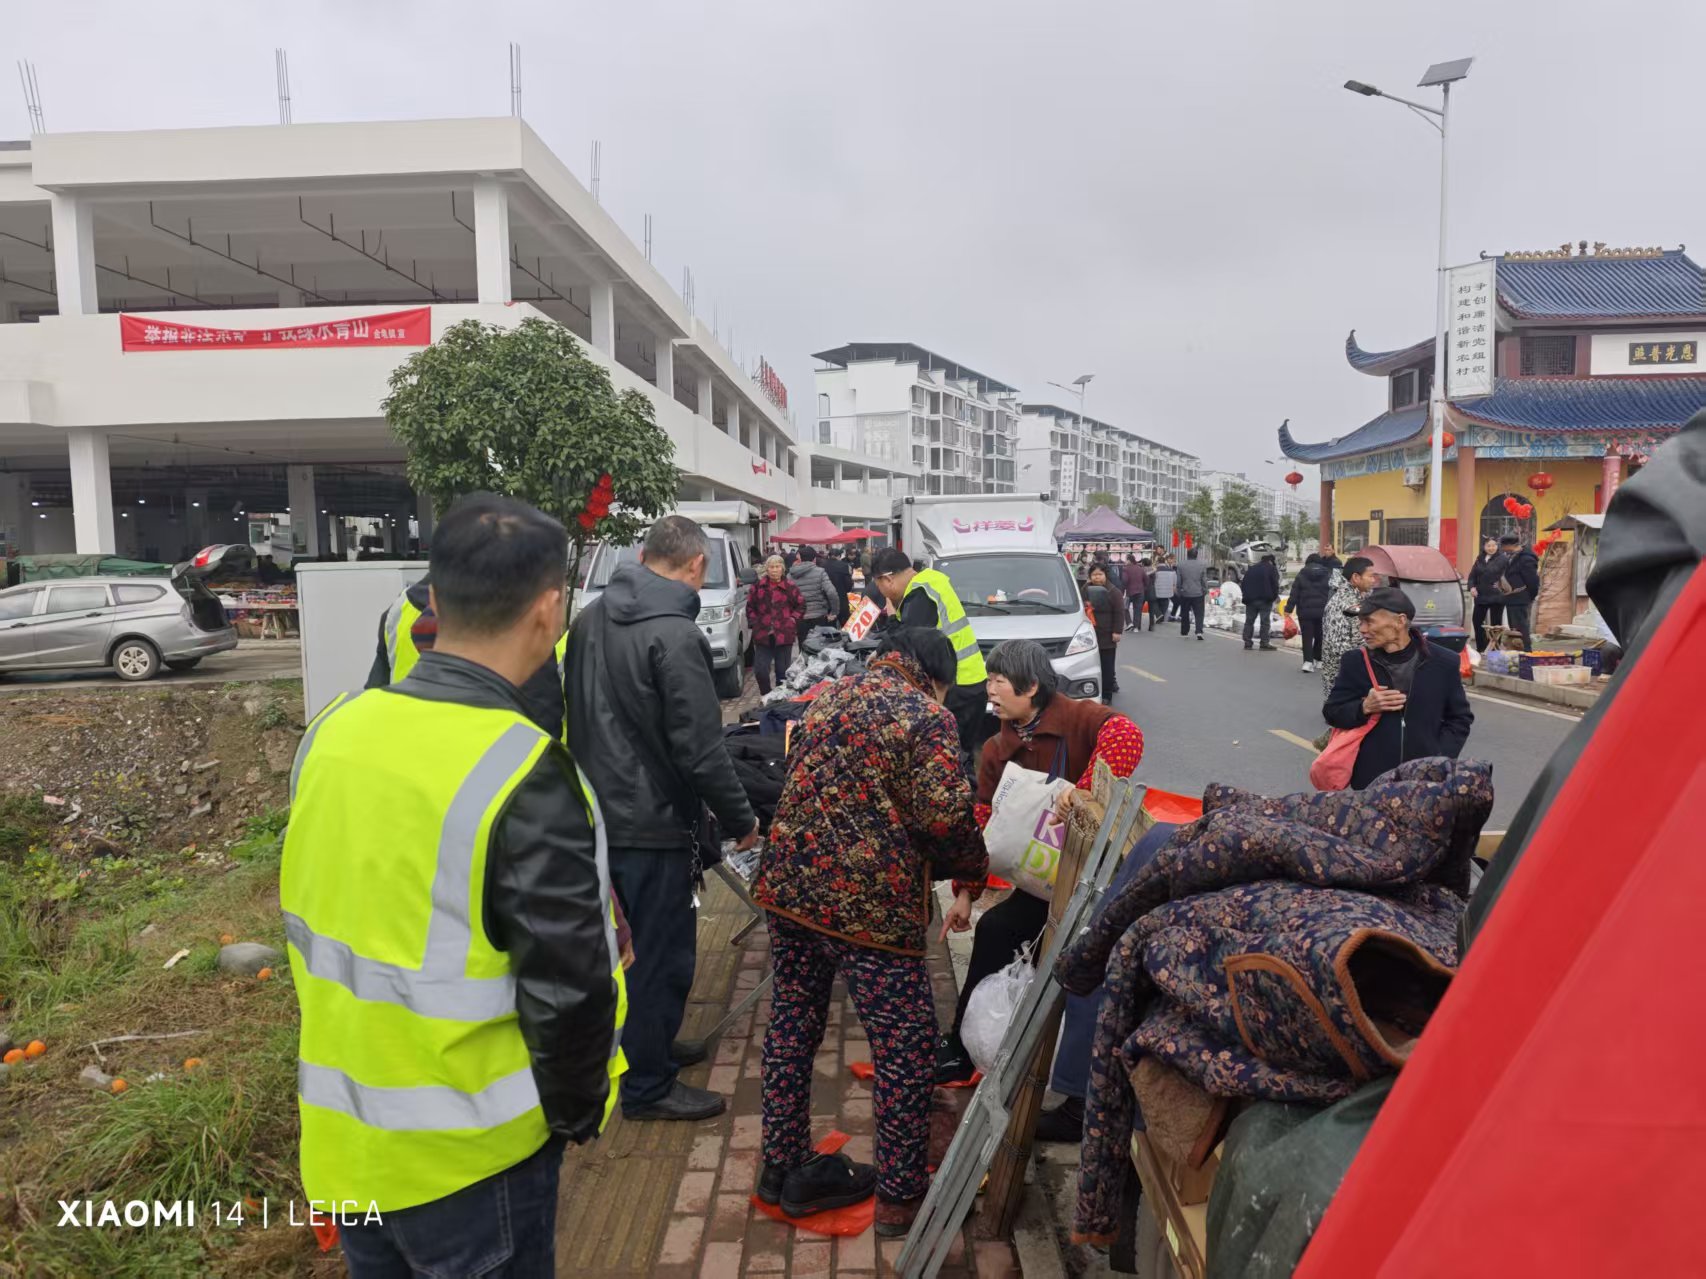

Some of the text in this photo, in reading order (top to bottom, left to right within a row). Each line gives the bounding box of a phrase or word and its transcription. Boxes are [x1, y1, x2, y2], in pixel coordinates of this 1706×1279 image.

[1455, 285, 1471, 376] 构建和谐新农村
[852, 610, 873, 639] 20
